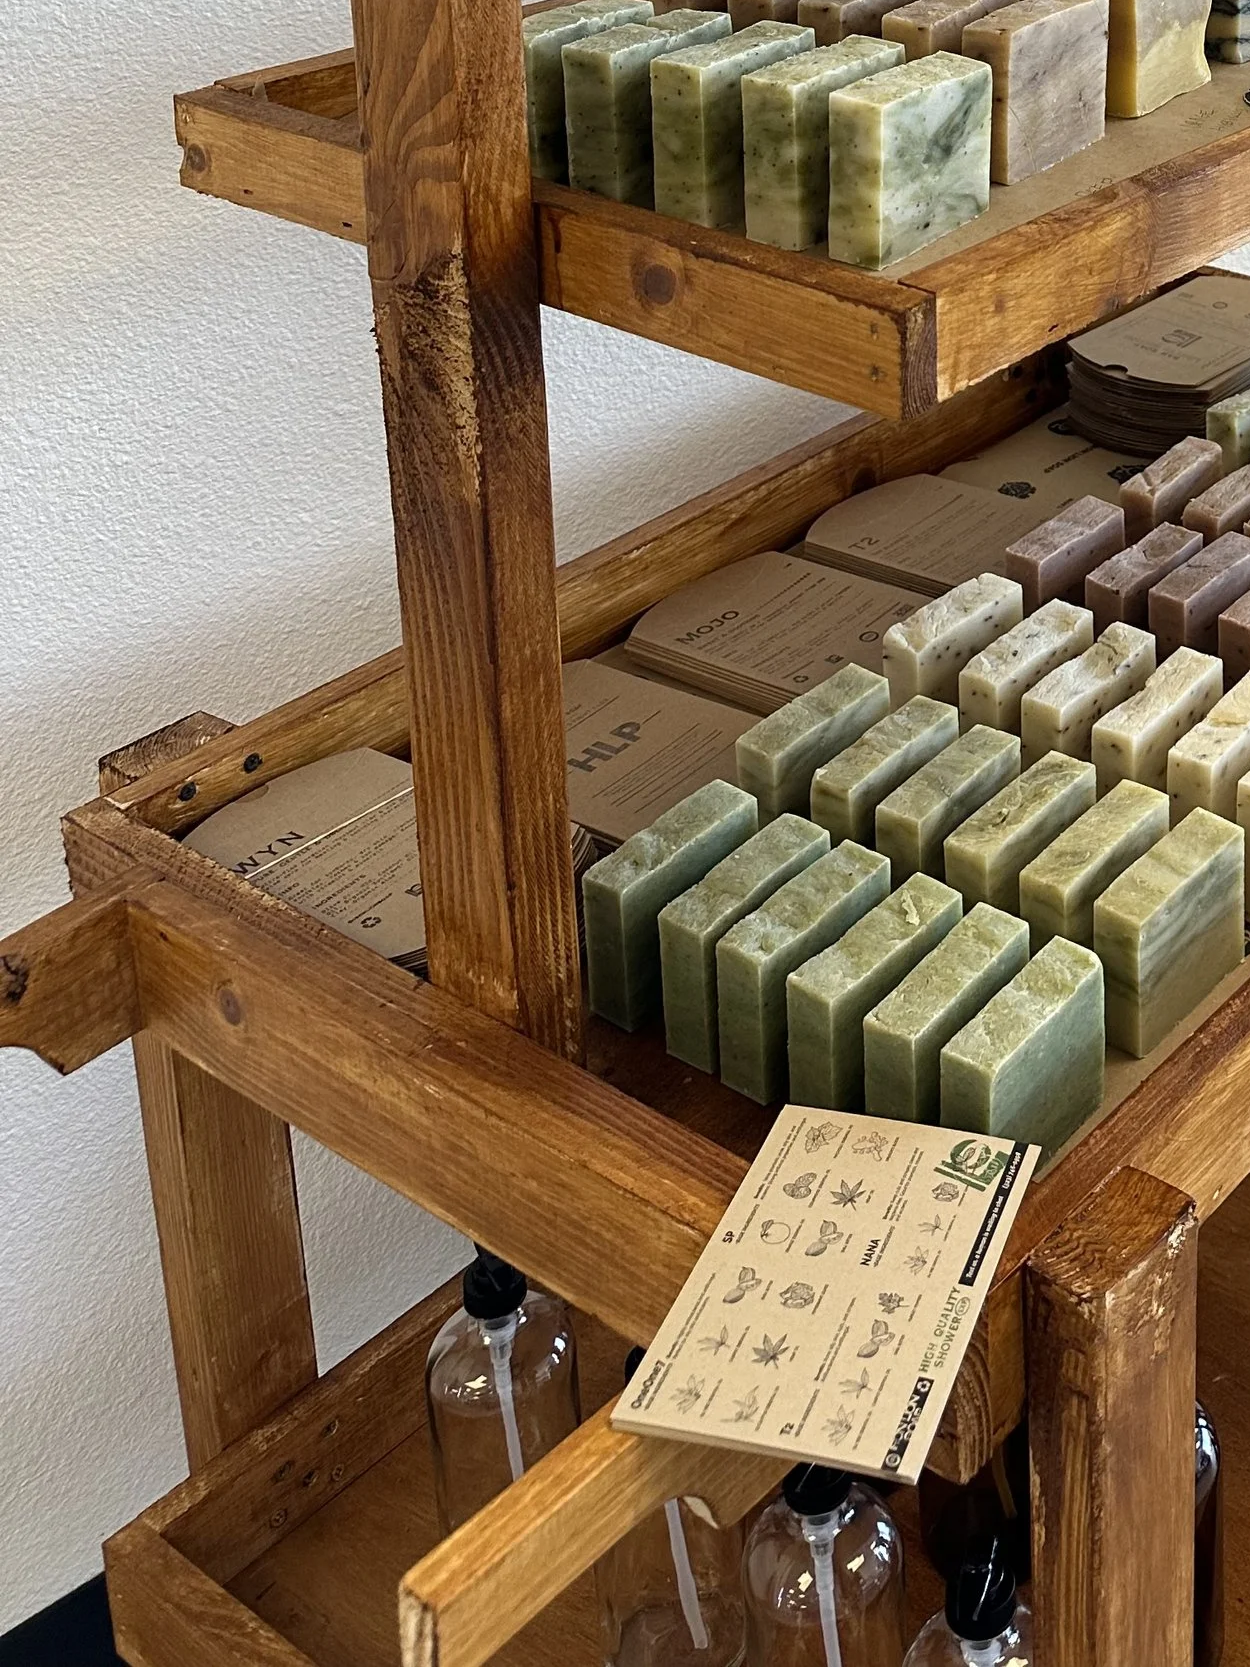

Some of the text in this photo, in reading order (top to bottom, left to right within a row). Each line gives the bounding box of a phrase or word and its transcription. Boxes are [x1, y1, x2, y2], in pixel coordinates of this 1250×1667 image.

[675, 608, 740, 645] MOJO
[566, 720, 642, 773] HLP
[233, 830, 305, 875] WYN
[722, 1231, 734, 1243] SP
[860, 1239, 880, 1266] NANA
[918, 1286, 960, 1372] HIGH QUALITY
[934, 1317, 961, 1367] SHOWER
[631, 1360, 664, 1409] OneOne7
[779, 1423, 794, 1435] T2
